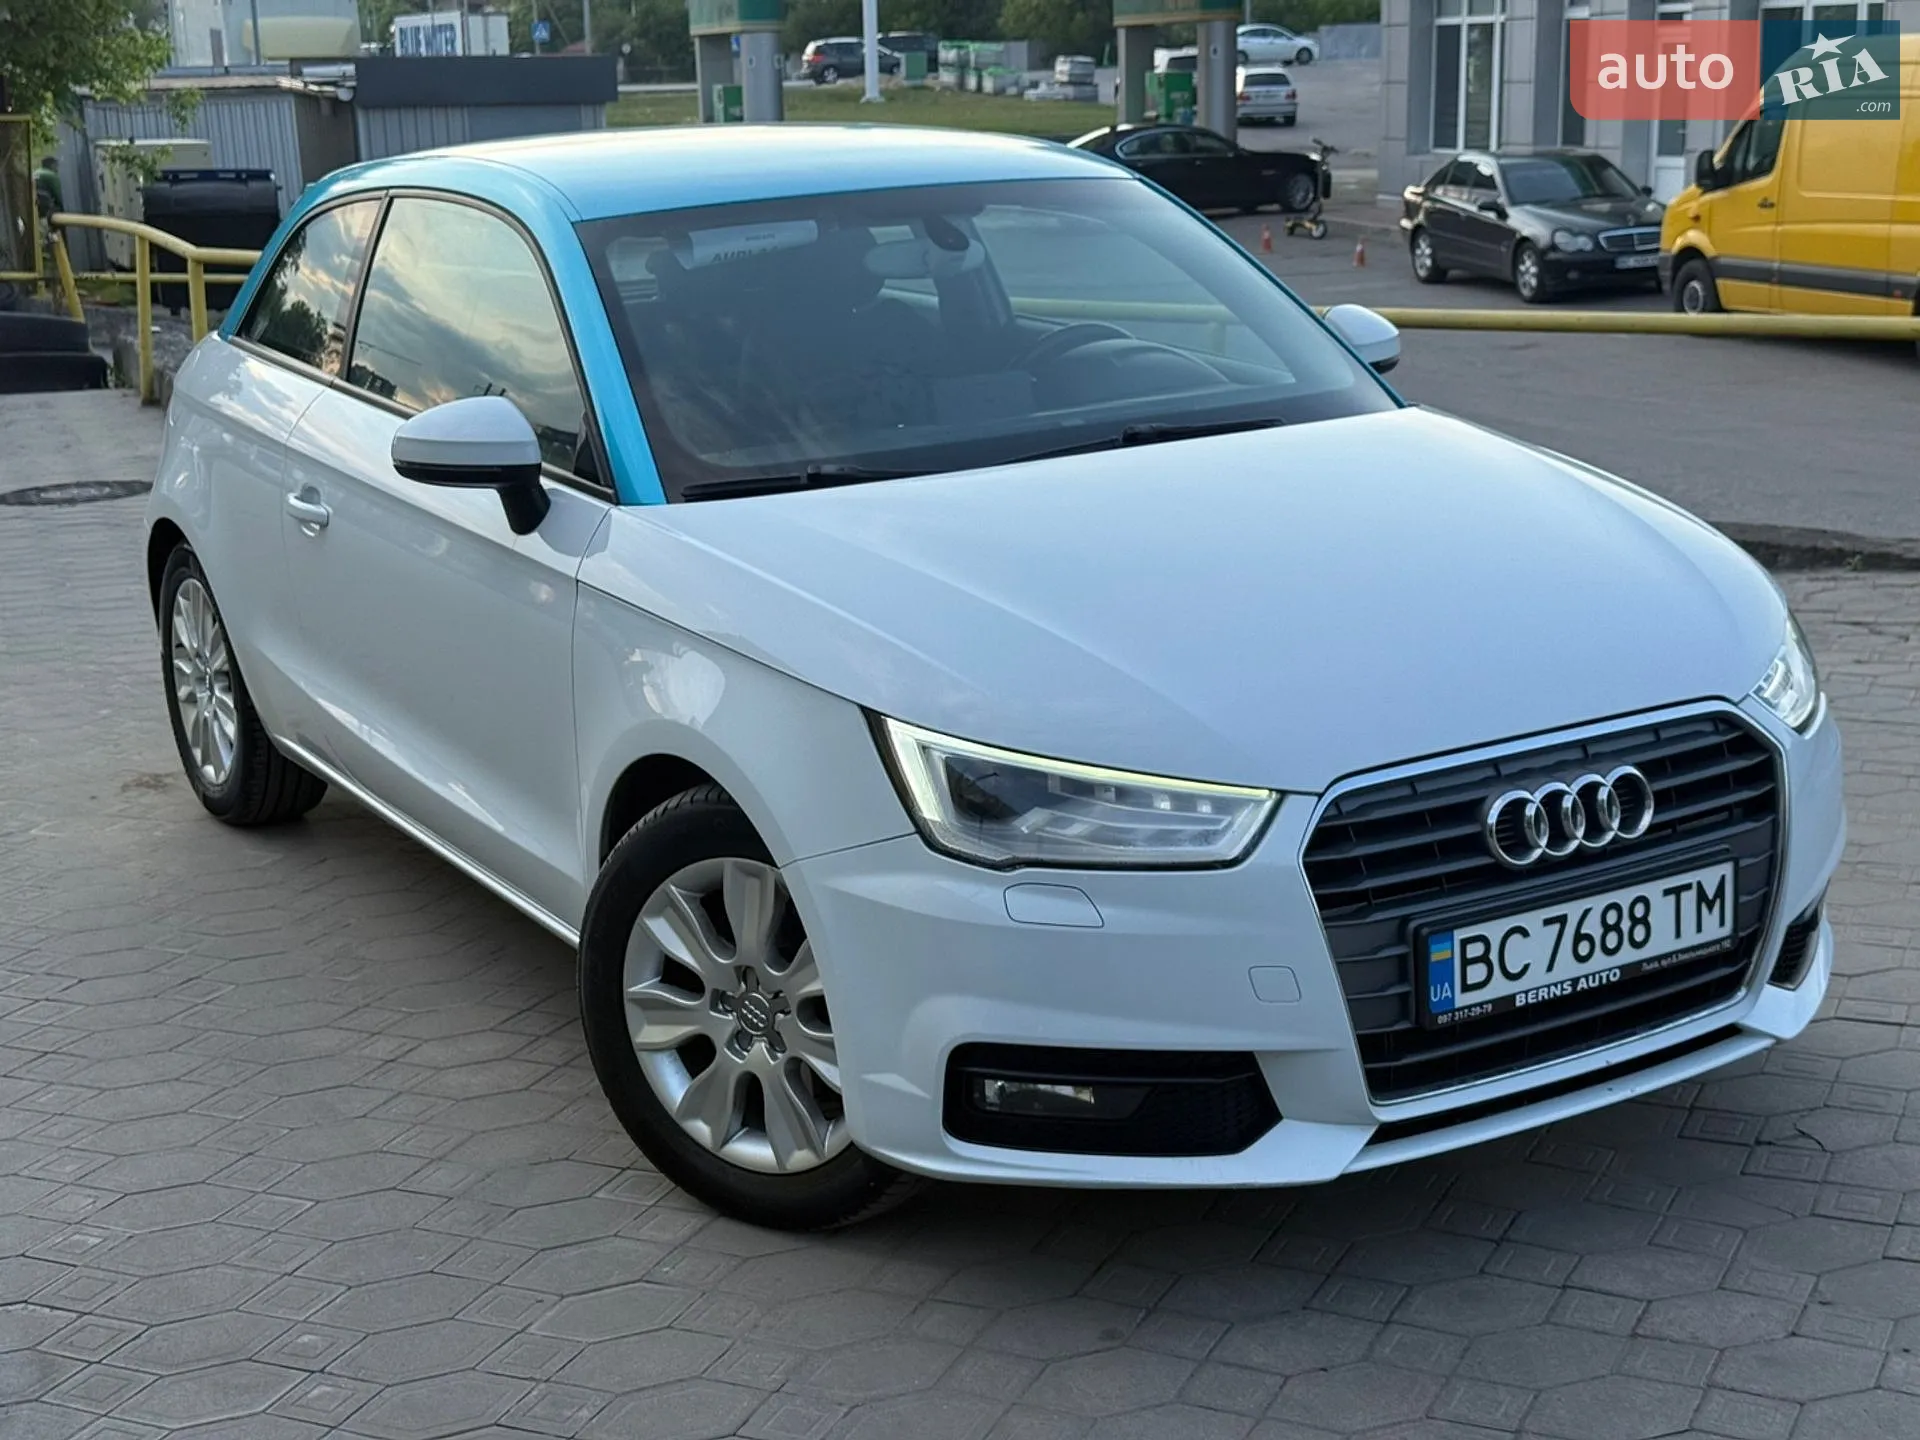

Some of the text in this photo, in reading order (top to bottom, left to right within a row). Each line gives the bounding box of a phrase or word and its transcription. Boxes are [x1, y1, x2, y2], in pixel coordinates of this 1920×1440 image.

[1459, 925, 1532, 994] BC
[1542, 895, 1651, 974] 7688
[1662, 873, 1727, 940] TM
[1430, 984, 1452, 1002] UA
[1515, 968, 1621, 1007] BERNS AUTO
